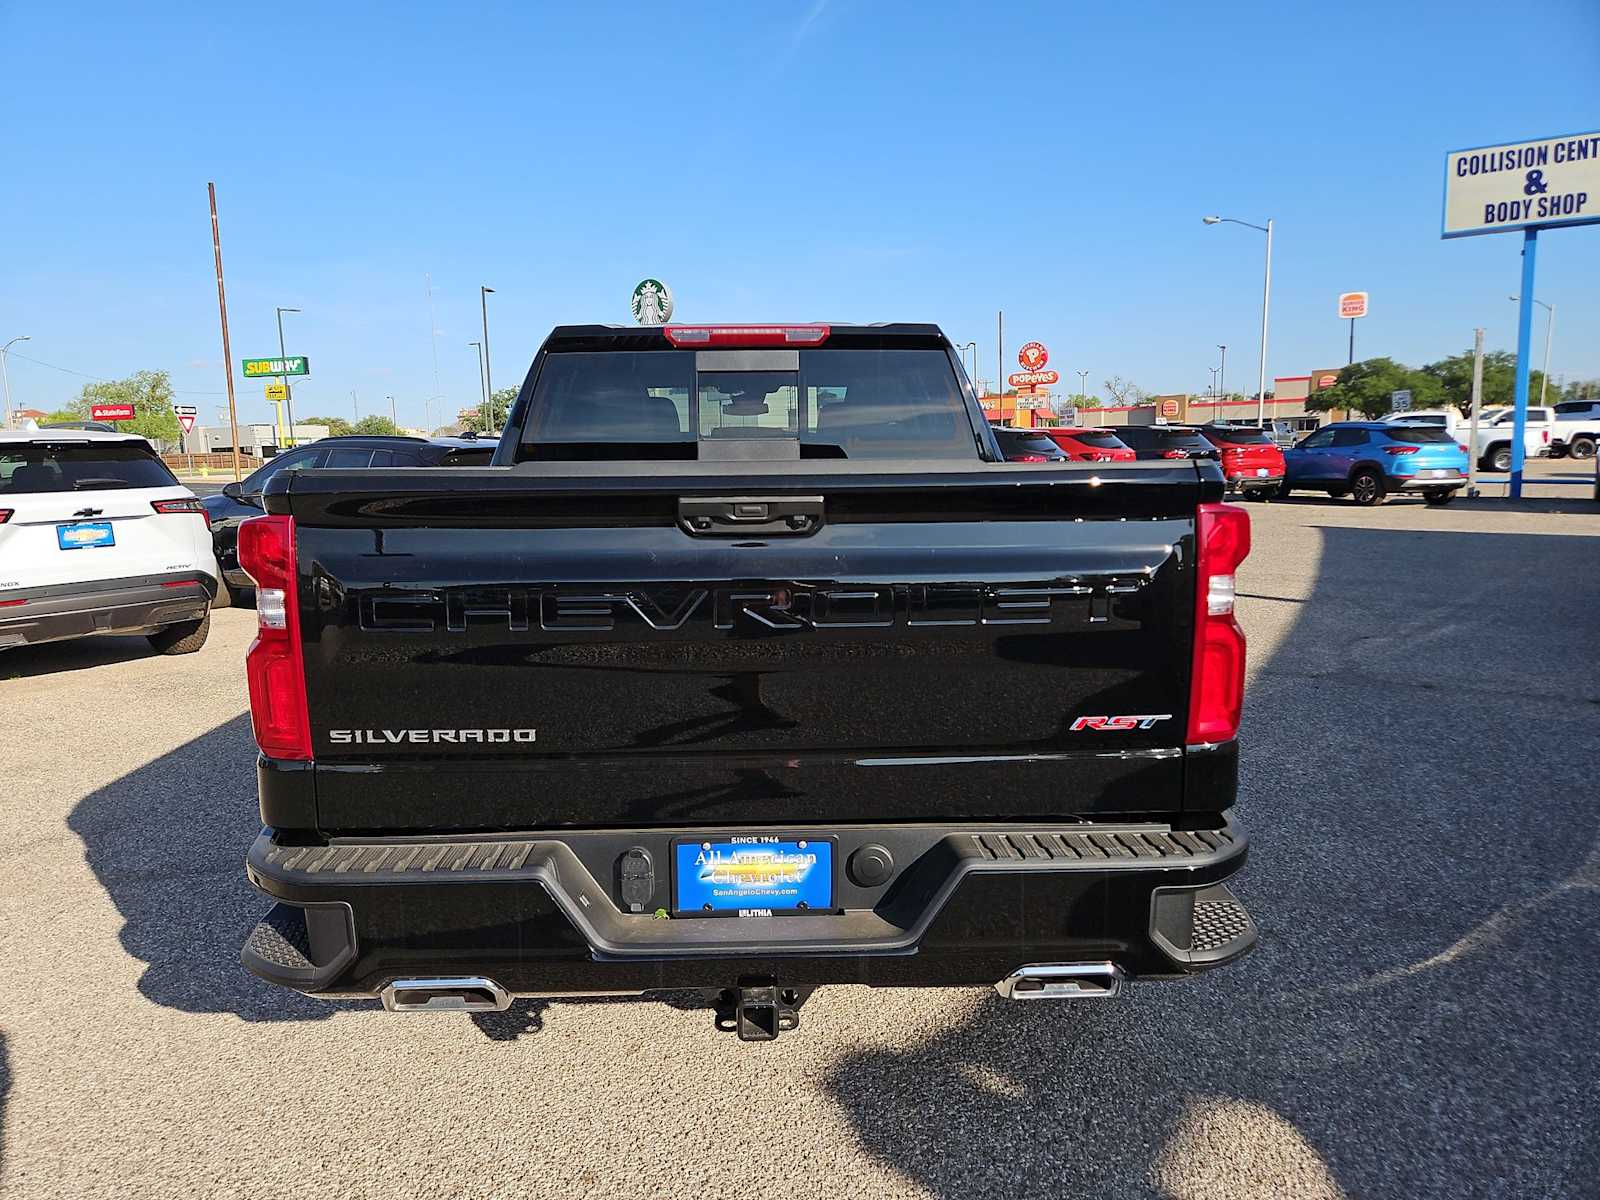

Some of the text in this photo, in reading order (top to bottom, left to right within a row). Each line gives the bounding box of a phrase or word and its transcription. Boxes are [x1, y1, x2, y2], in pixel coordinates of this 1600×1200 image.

[1456, 137, 1600, 177] COLLISION CENT
[1524, 169, 1548, 195] &
[1484, 192, 1588, 223] BODY SHOP
[245, 359, 301, 375] SUBWAY
[359, 583, 1141, 632] CHEVROLET
[1069, 714, 1172, 731] RST
[329, 728, 537, 744] SILVERADO
[694, 850, 817, 865] All American
[711, 868, 802, 884] Chevrolet
[712, 888, 798, 896] SanAngeloChevy.com
